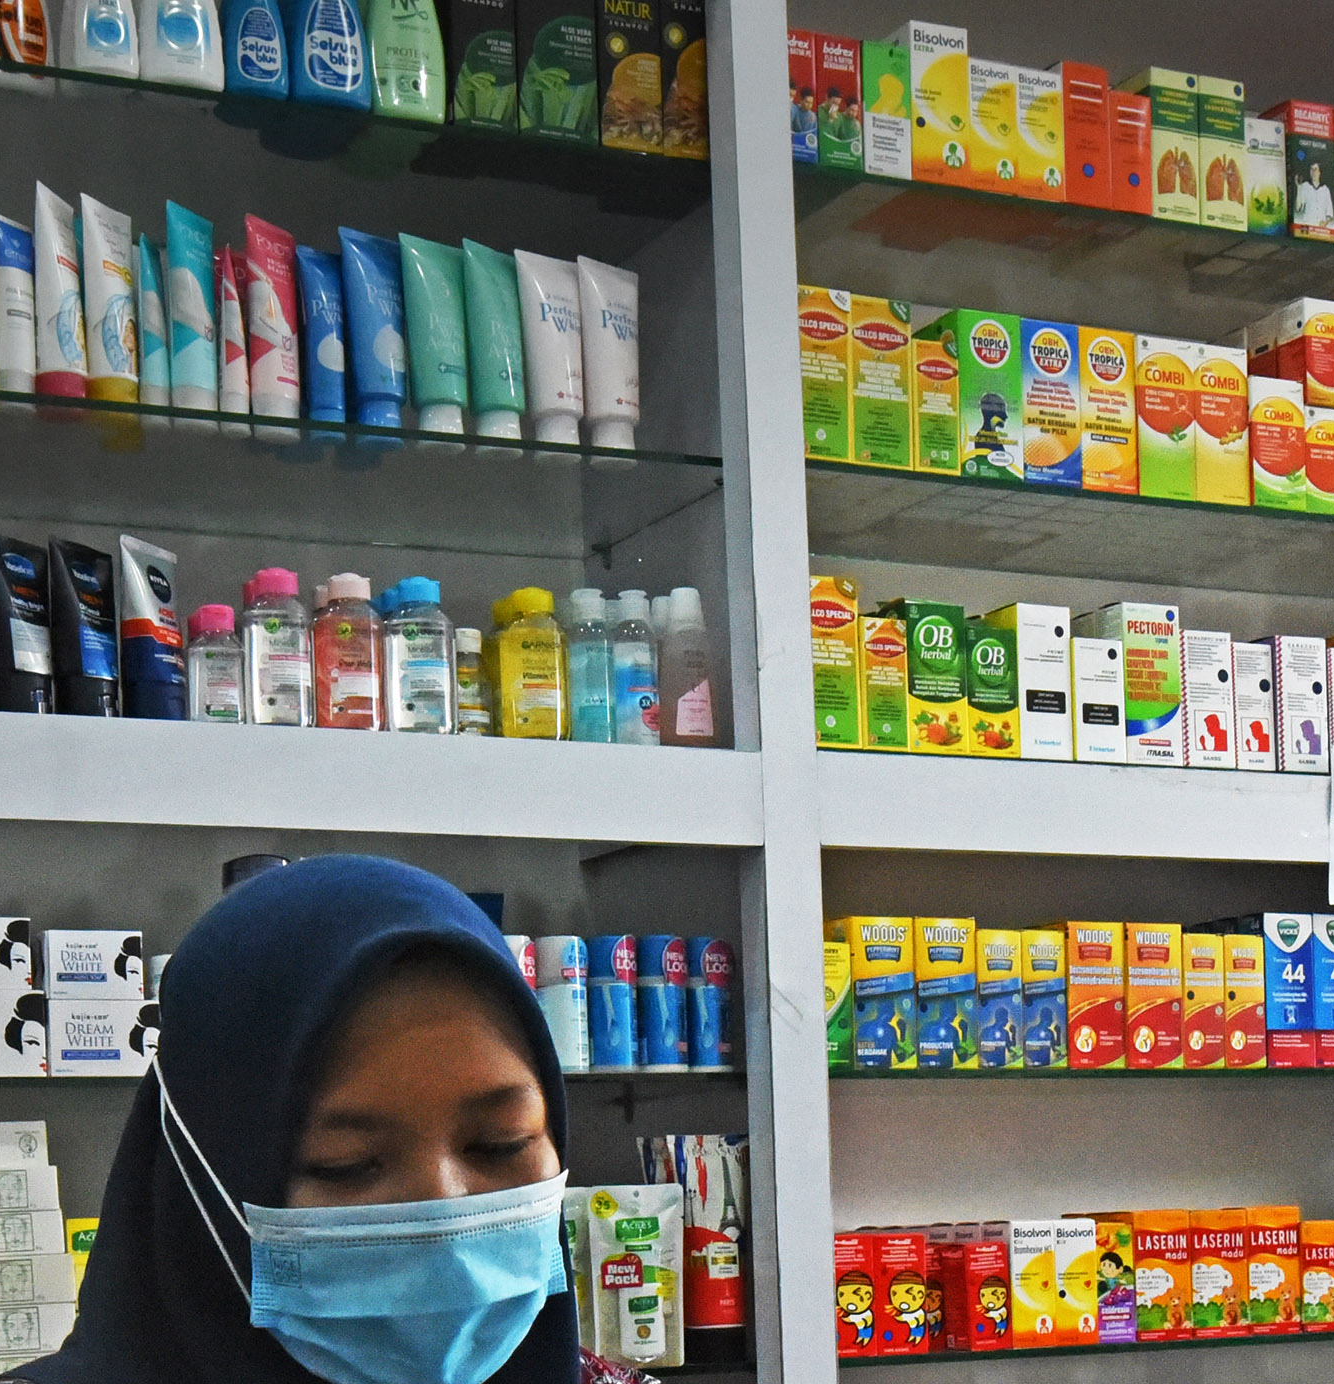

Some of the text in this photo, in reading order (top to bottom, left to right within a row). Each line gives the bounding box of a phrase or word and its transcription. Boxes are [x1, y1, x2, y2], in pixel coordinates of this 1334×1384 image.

[241, 39, 277, 54] Selsun
[310, 35, 356, 54] Selsun
[914, 29, 964, 50] Bisolvon
[823, 42, 854, 57] bodrex
[255, 51, 278, 65] blue
[328, 52, 358, 68] blue
[971, 65, 1010, 81] Bisolvon
[1018, 73, 1057, 89] Bisolvon
[982, 328, 998, 338] OBH
[971, 337, 1010, 350] TROPICA
[1042, 338, 1059, 348] OBH
[1098, 345, 1115, 355] OBH
[981, 349, 1001, 359] PLUS
[1031, 345, 1069, 360] TROPICA
[1040, 356, 1063, 369] EXTRA
[1088, 353, 1125, 368] TROPICA
[1145, 367, 1185, 386] COMBI
[1200, 375, 1240, 392] COMBI
[1264, 407, 1295, 423] COMBI
[149, 571, 170, 592] NIVEA
[1127, 620, 1175, 637] PECTORIN
[918, 624, 953, 650] OB
[920, 646, 953, 663] herbal
[976, 645, 1005, 667] OB
[977, 663, 1005, 678] herbal
[1280, 929, 1299, 937] VICKS
[60, 950, 103, 964] DREAM
[616, 949, 635, 960] NEW
[667, 951, 684, 962] NEW
[705, 952, 727, 963] NEW
[62, 961, 103, 973] WHITE
[1282, 964, 1306, 983] 44
[65, 1022, 114, 1035] DREAM
[68, 1034, 114, 1048] WHITE
[1014, 1226, 1052, 1240] Bisolvon
[1056, 1226, 1095, 1240] Bisolvon
[1194, 1232, 1243, 1249] LASERIN
[1251, 1229, 1297, 1247] LASERIN
[1137, 1233, 1188, 1252] LASERIN
[1276, 1244, 1298, 1256] madu
[1165, 1249, 1188, 1261] madu
[1221, 1248, 1244, 1258] madu
[608, 1264, 636, 1276] New
[605, 1272, 640, 1287] Pack
